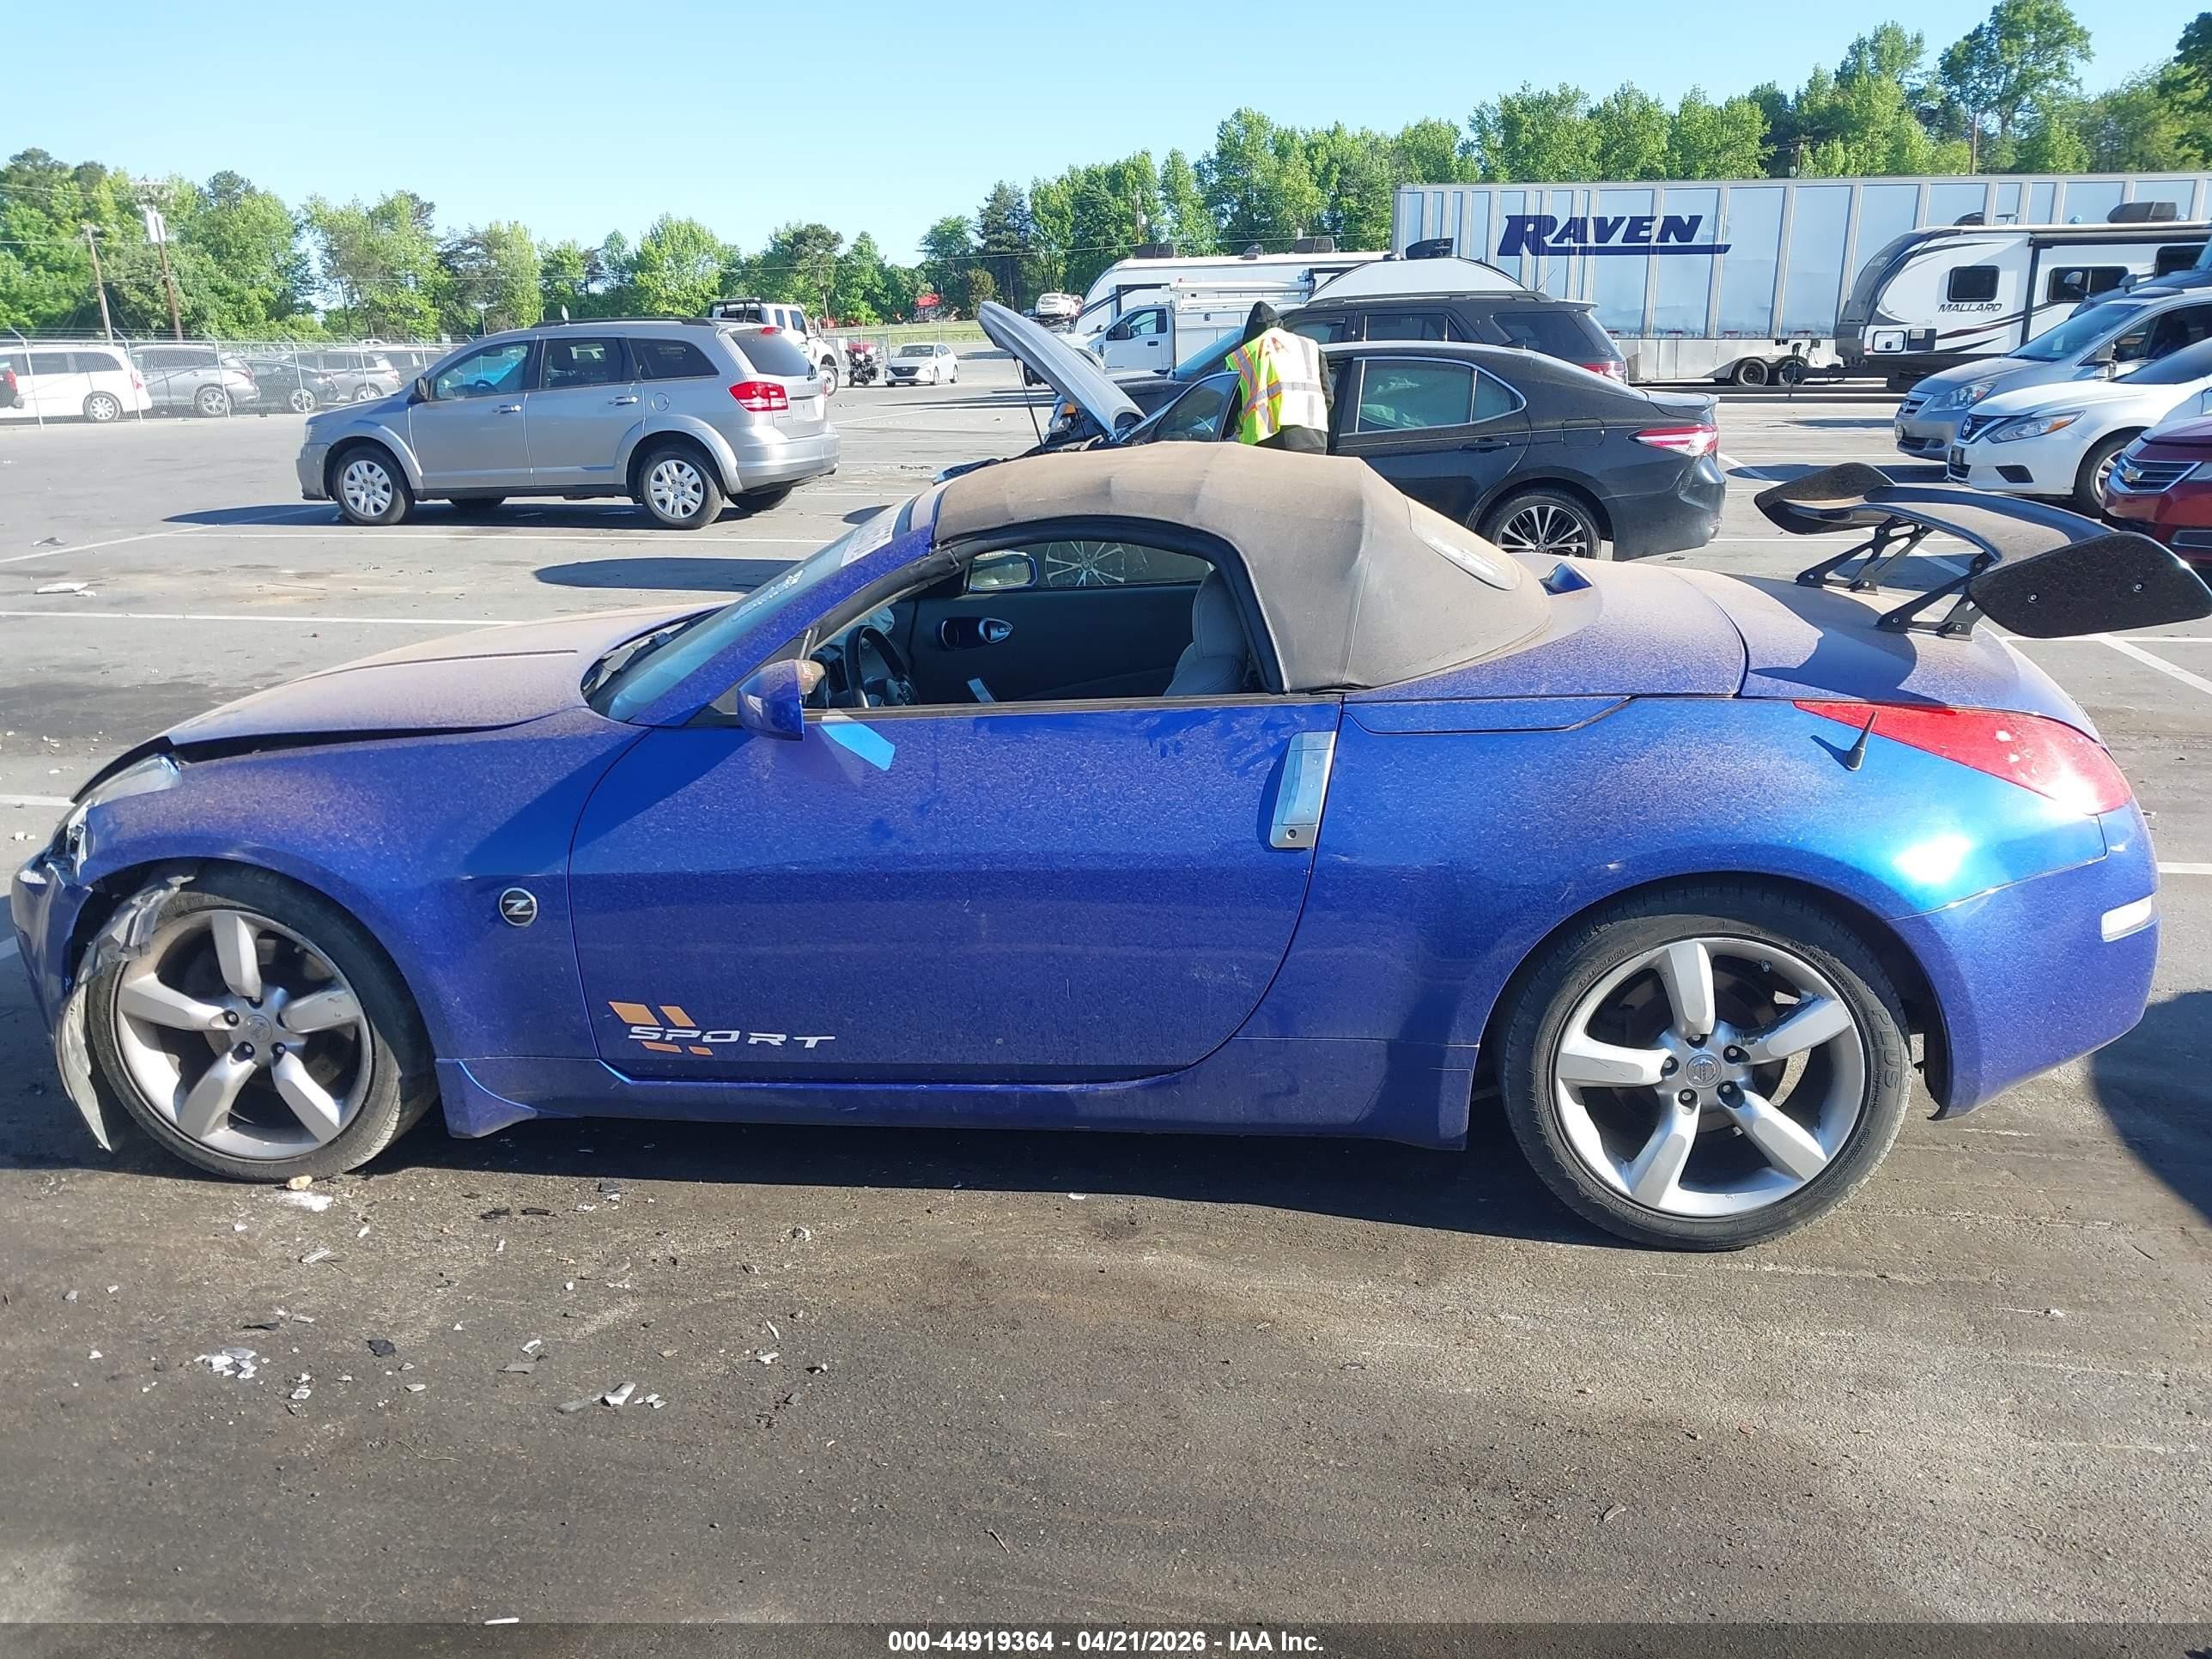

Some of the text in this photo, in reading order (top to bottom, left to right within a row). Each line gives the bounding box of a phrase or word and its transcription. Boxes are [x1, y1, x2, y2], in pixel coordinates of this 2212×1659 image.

[1937, 302, 2003, 313] MALLARD
[628, 1025, 836, 1049] SPORT
[1872, 1008, 1899, 1090] PLUS
